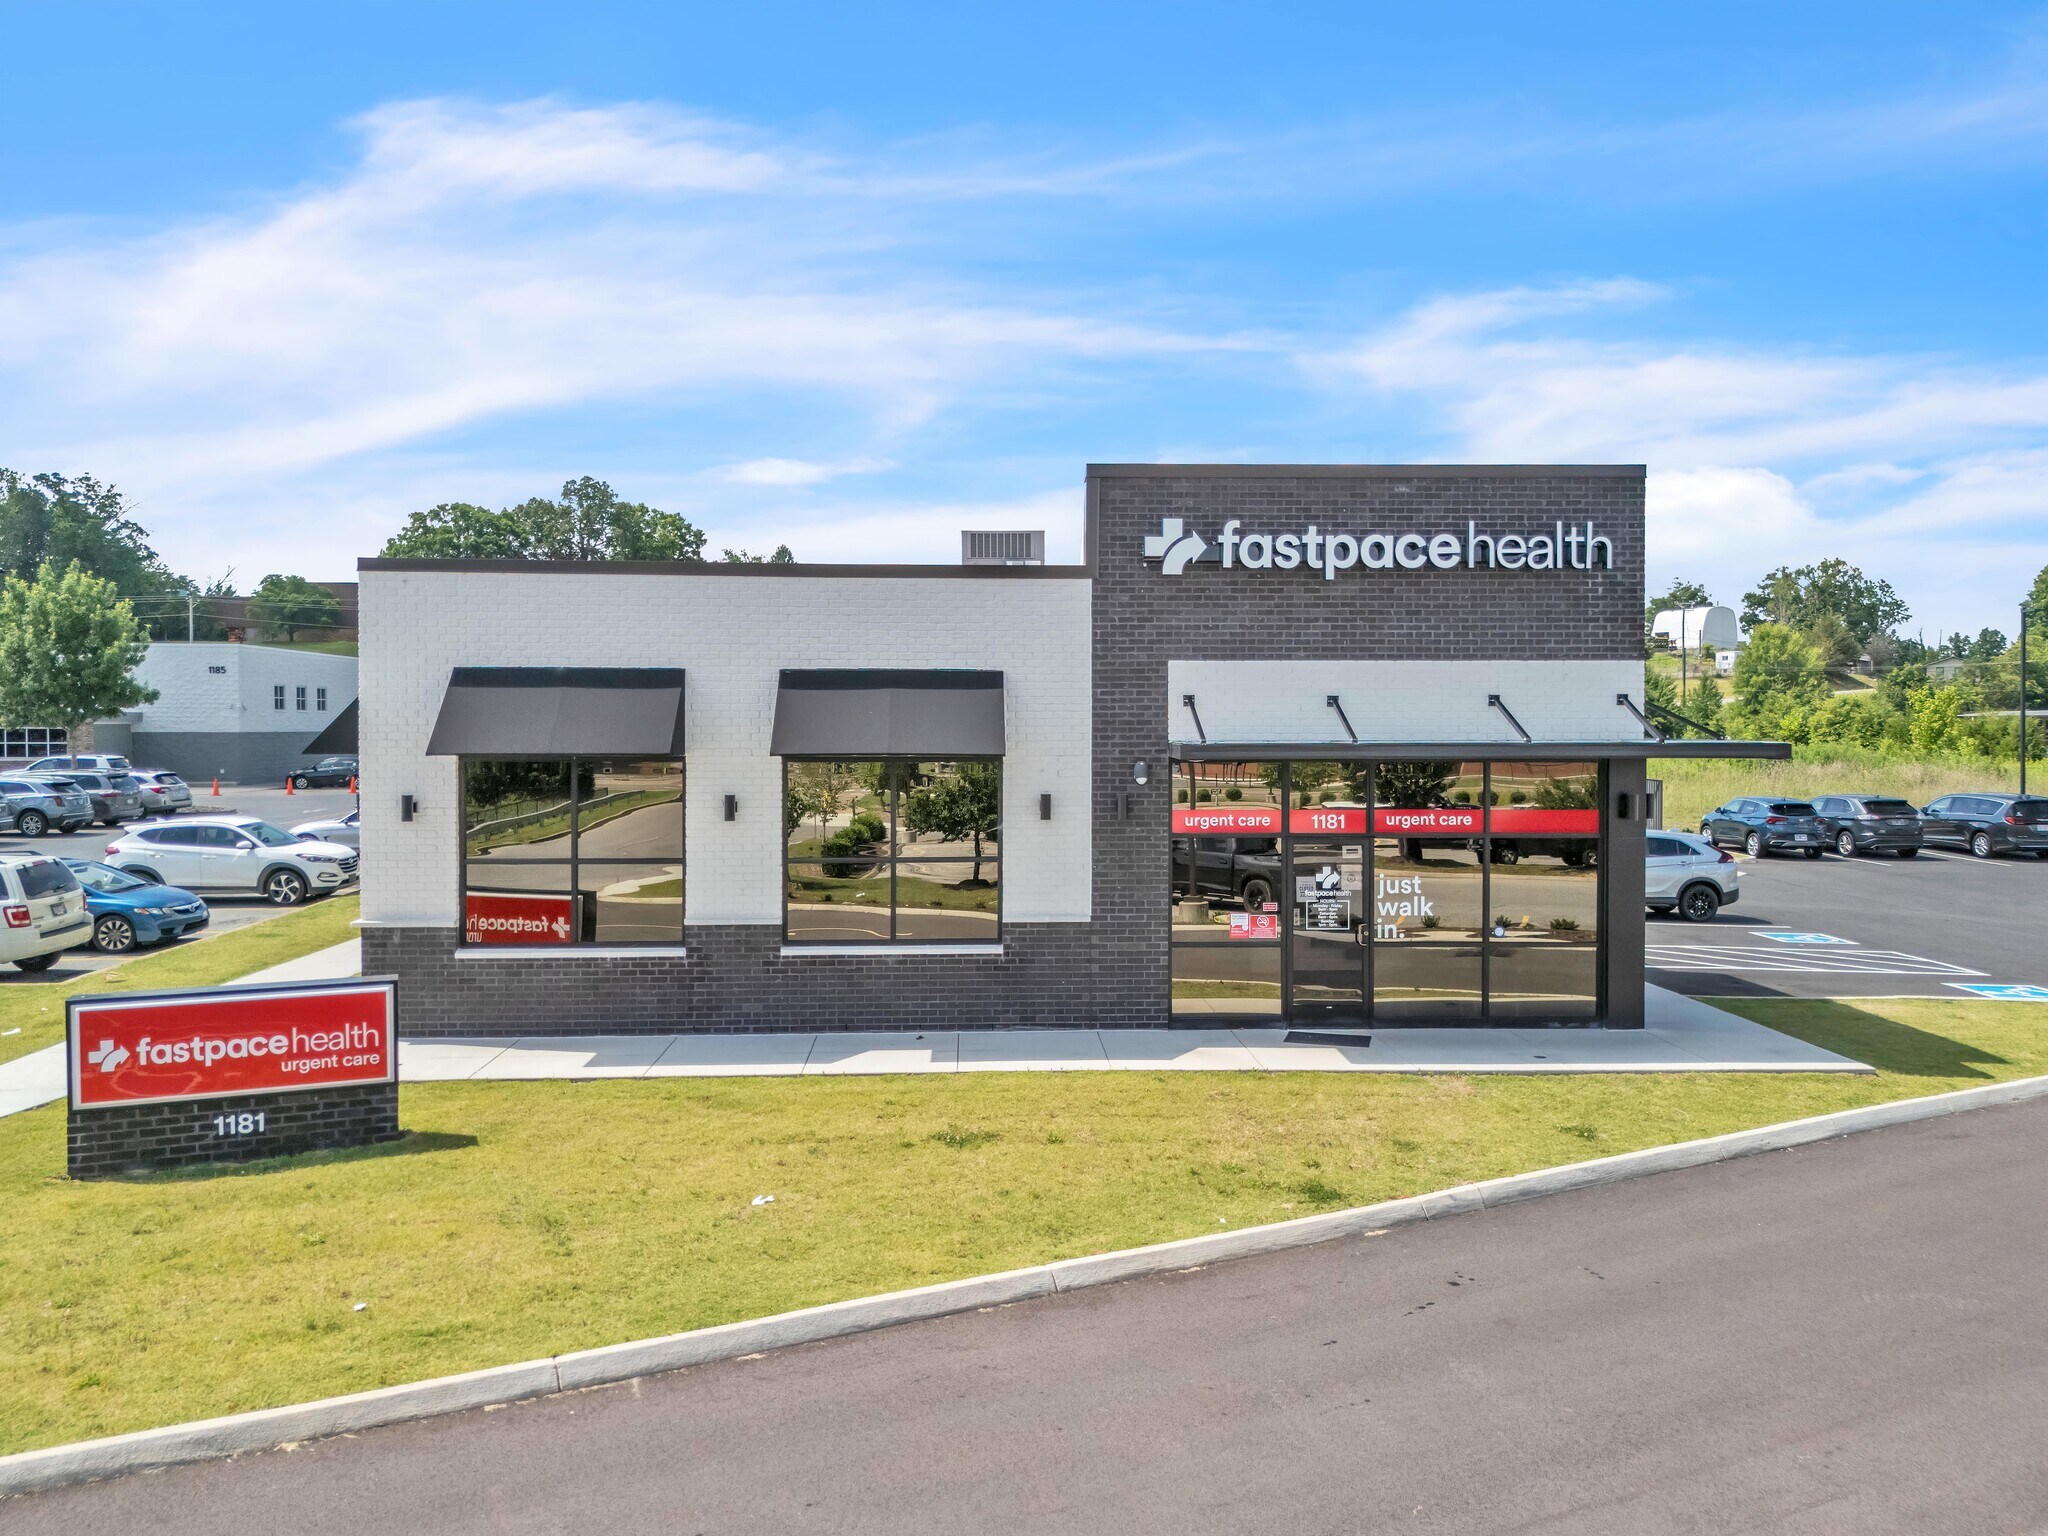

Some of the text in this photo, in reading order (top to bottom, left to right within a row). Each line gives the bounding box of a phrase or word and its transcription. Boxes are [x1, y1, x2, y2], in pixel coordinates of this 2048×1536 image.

[208, 666, 226, 674] 1185
[1184, 814, 1271, 829] urgent care
[1311, 814, 1346, 829] 1181
[1386, 813, 1472, 829] urgent care
[1377, 873, 1422, 898] just
[1377, 896, 1434, 916] walk
[1377, 918, 1405, 939] in.
[281, 1053, 380, 1074] urgent care
[213, 1112, 266, 1137] 1181
